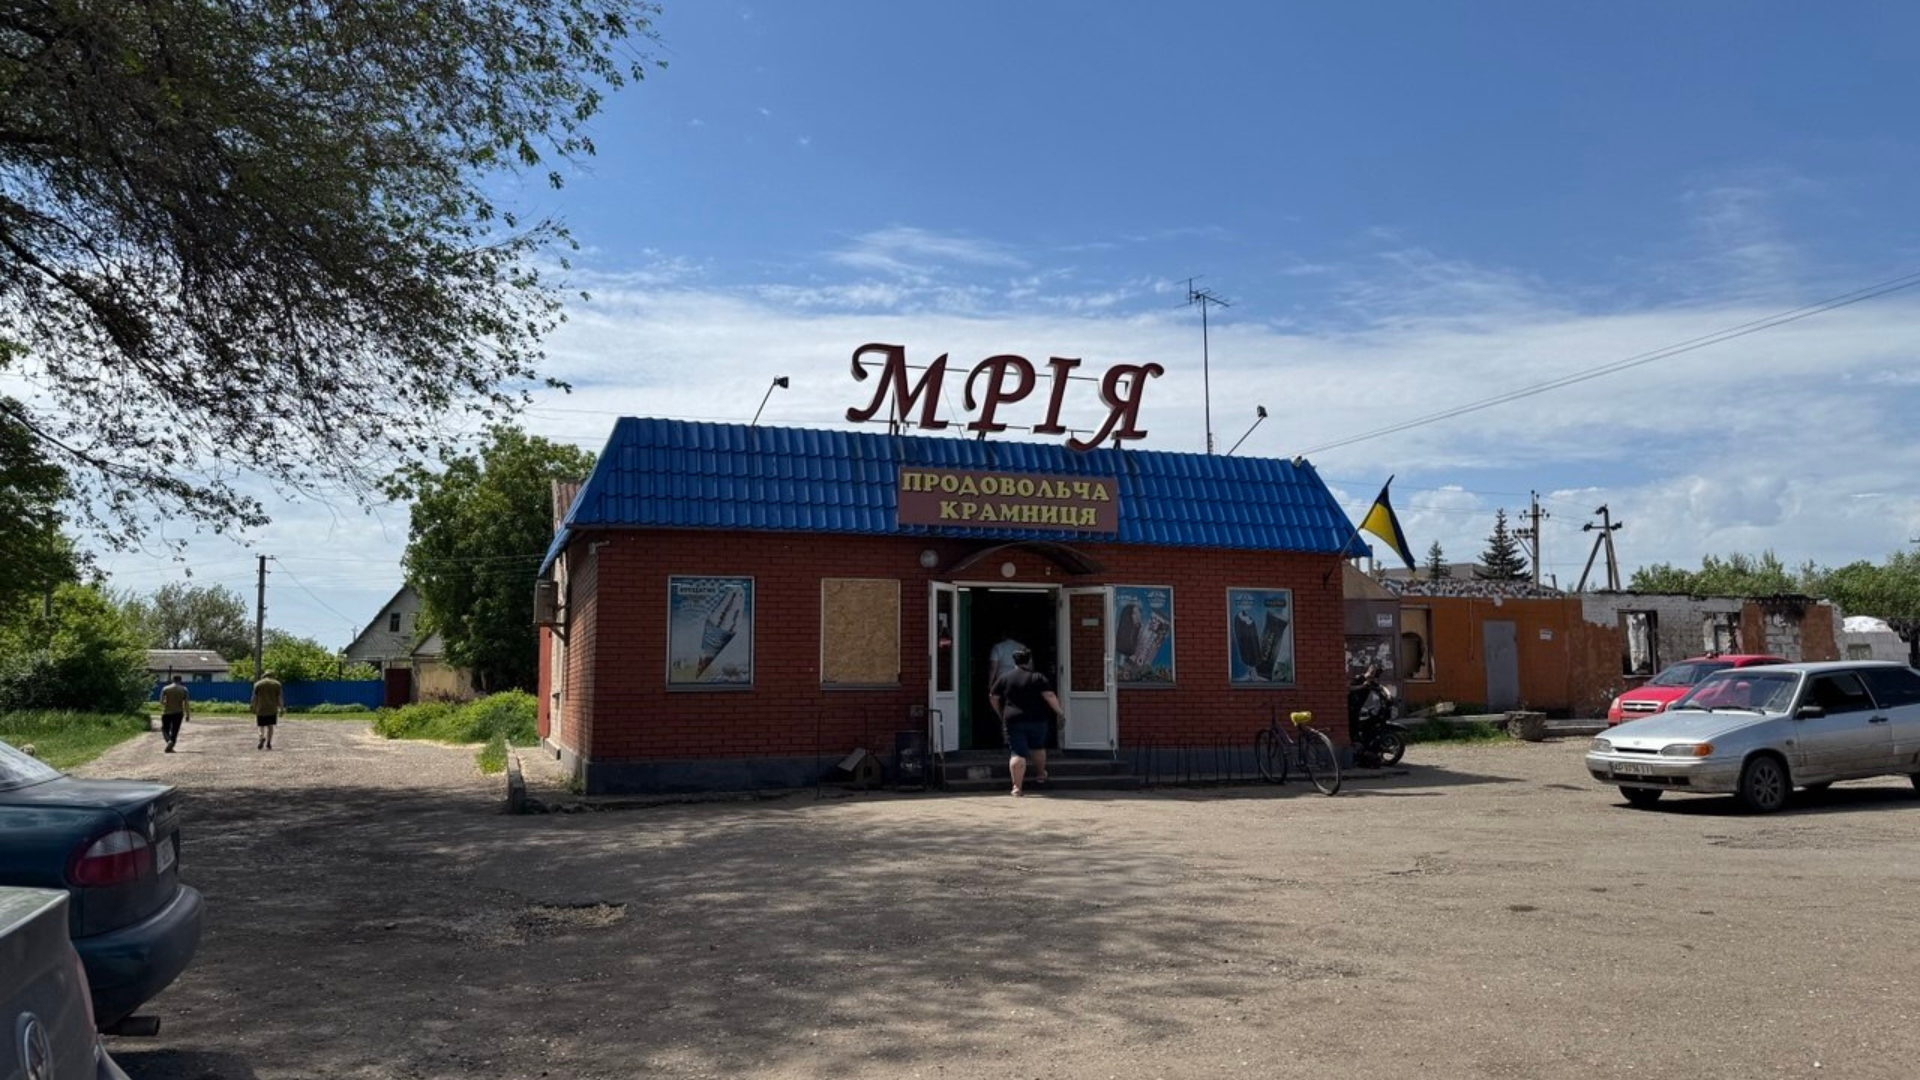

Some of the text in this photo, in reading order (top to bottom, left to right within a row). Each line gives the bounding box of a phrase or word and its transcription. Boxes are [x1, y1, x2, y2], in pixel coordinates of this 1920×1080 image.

[846, 343, 1164, 450] МРІЯ
[901, 472, 1109, 501] ПРОДОВОЛЬЧА
[939, 500, 1097, 526] КРАМНИЦЯ
